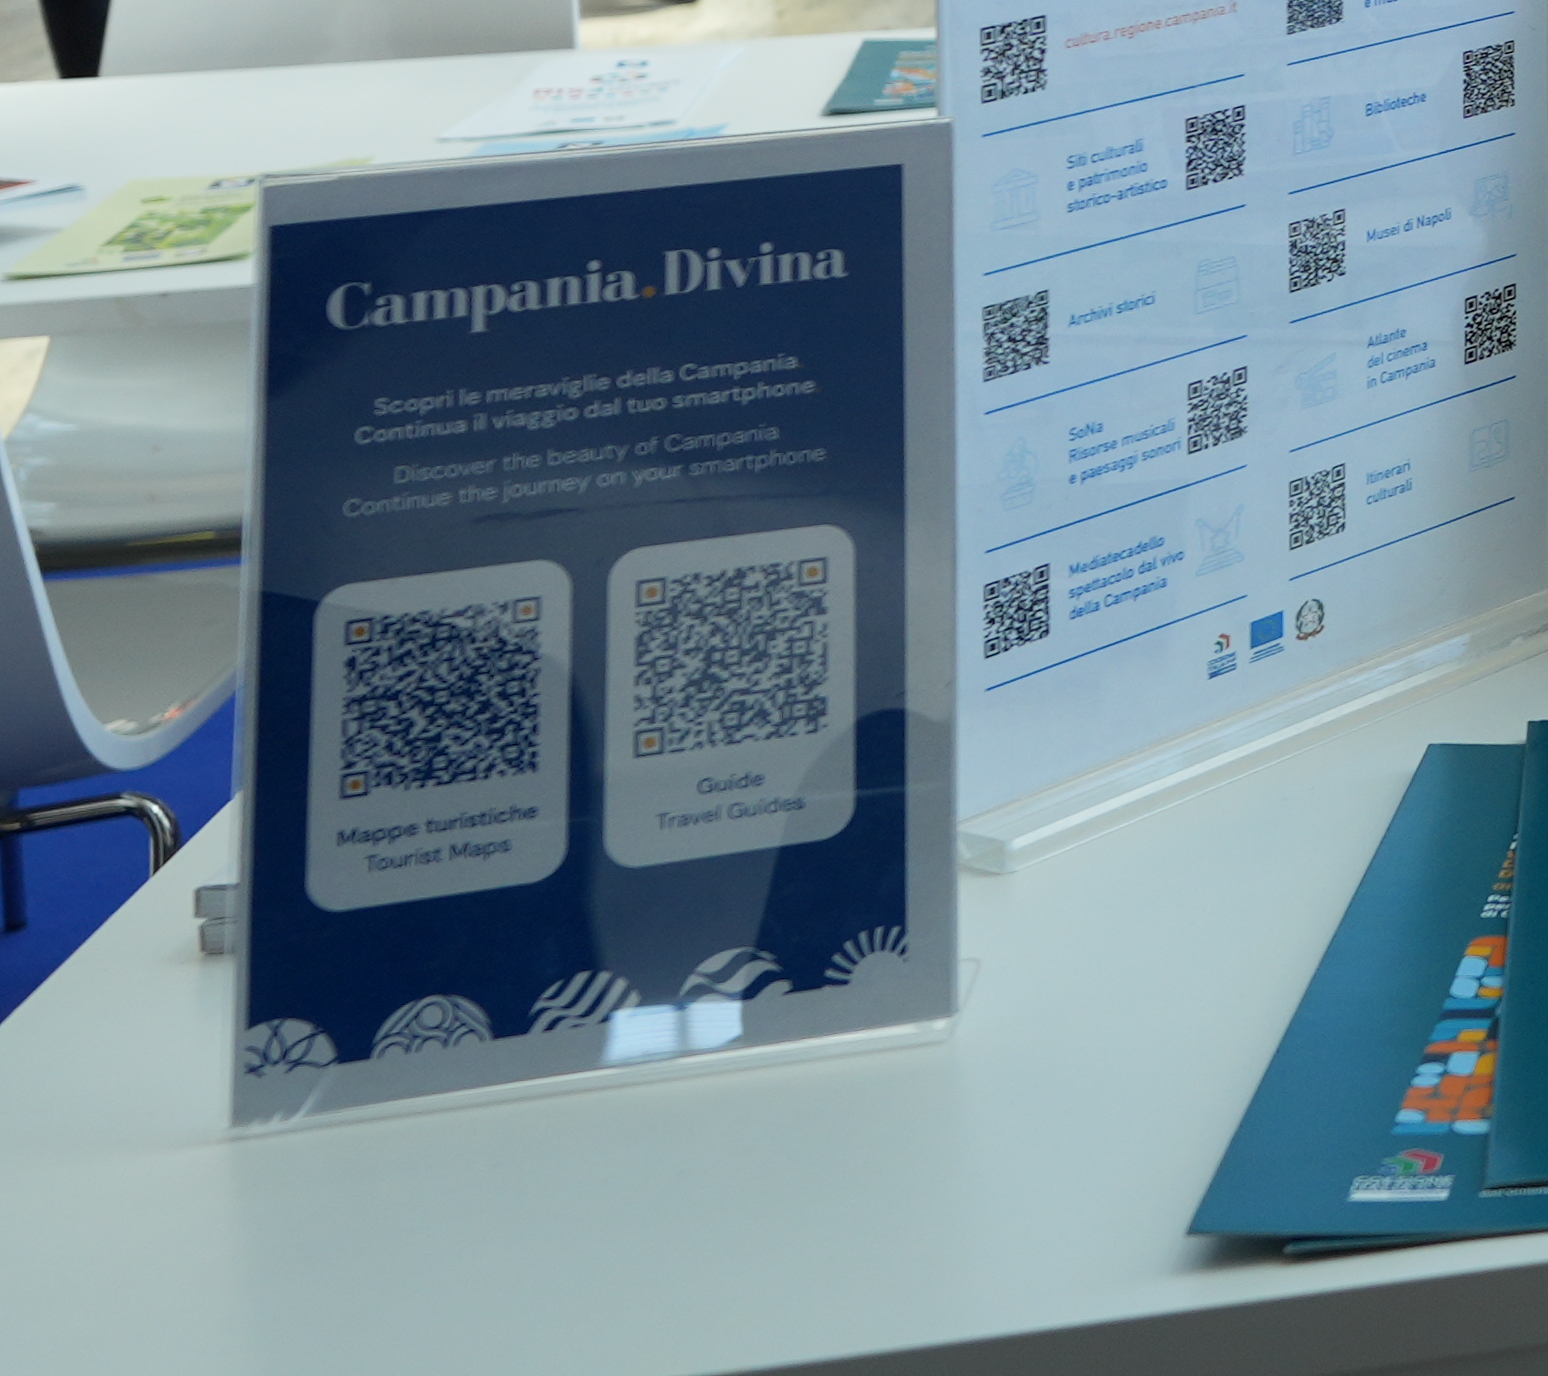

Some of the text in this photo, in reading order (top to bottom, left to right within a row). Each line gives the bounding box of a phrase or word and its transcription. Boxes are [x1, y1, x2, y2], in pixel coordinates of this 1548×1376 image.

[1364, 91, 1428, 117] Biblioteche
[1066, 159, 1149, 193] e patrimonio
[1066, 177, 1169, 214] storico-artistico
[1366, 207, 1453, 243] Musei di Napoli
[1067, 290, 1156, 328] Archivi storici
[1366, 326, 1408, 349] Atlante
[1366, 340, 1429, 370] del cinema
[1366, 356, 1437, 390] in Campania
[372, 391, 455, 418] Scopri
[458, 388, 481, 407] le
[485, 371, 611, 405] meraviglie
[615, 366, 675, 390] della
[353, 414, 468, 447] Continua
[472, 408, 487, 431] il
[491, 403, 580, 432] viaggio
[582, 397, 623, 419] dal
[626, 395, 668, 415] tuo
[392, 422, 781, 485] Discover the beauty of Campania
[1068, 417, 1176, 464] Risorse musicali
[1068, 436, 1183, 485] e paesaggi sonori
[1366, 458, 1412, 487] Itinerari
[341, 445, 829, 519] Continue the journey on your smartphone
[1366, 477, 1413, 506] culturali
[1068, 549, 1186, 600] spettacolo dal vivo
[1068, 575, 1169, 621] della Campania
[696, 771, 767, 796] Guide
[335, 802, 541, 850] Mappe turistiche
[655, 793, 808, 832] Travel Guides
[363, 836, 514, 873] Tourist Maps
